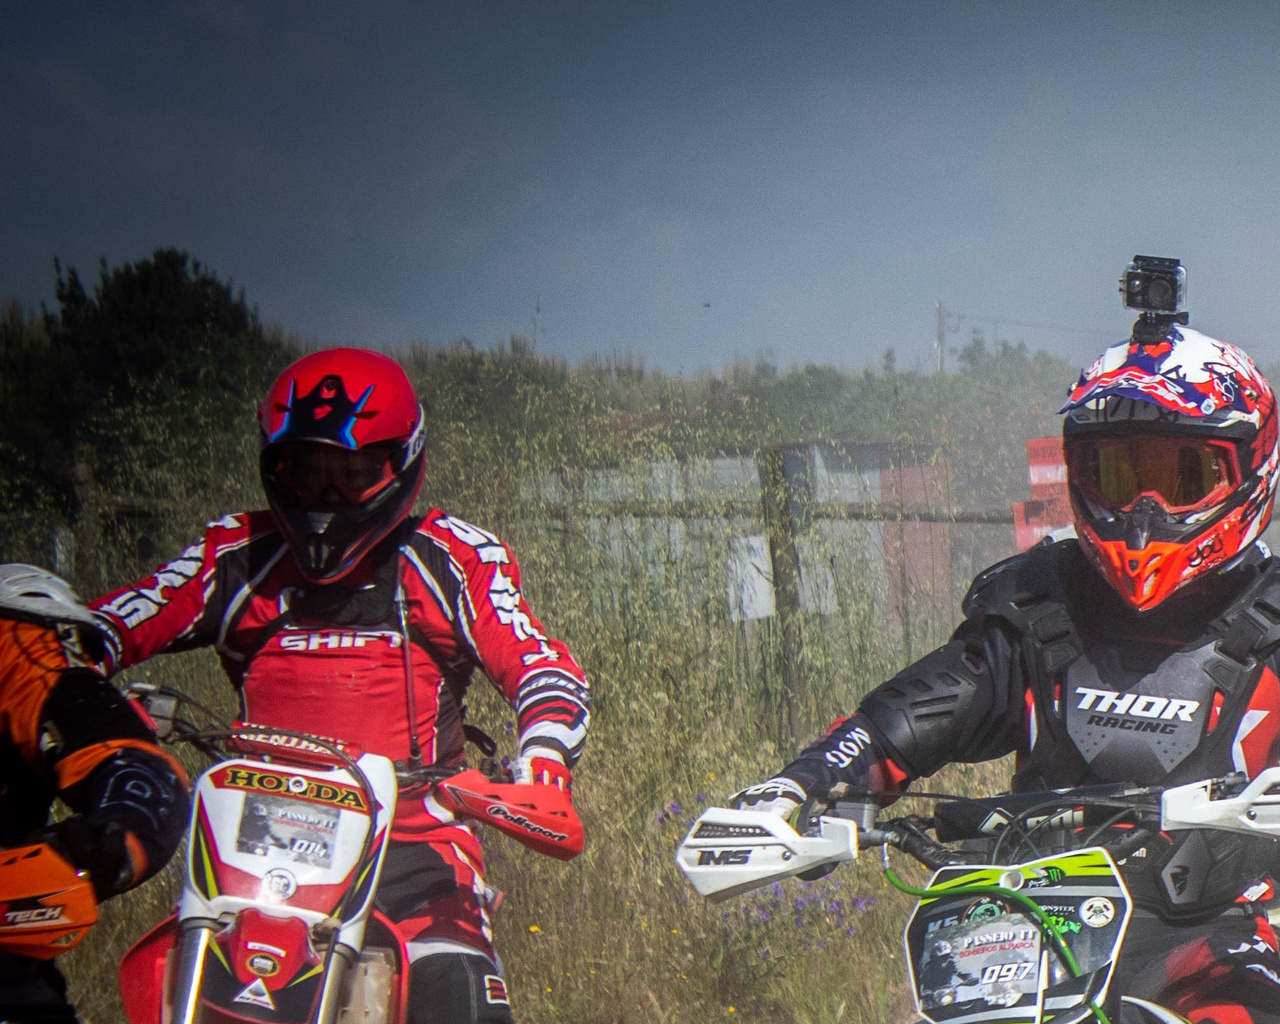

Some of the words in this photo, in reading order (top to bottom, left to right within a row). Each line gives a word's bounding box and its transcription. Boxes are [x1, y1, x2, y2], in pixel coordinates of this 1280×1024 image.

[280, 630, 403, 651] SHIFT
[1075, 686, 1200, 722] THOR
[1086, 714, 1179, 735] RACING
[291, 839, 329, 859] 014
[1038, 904, 1076, 913] ONSTER
